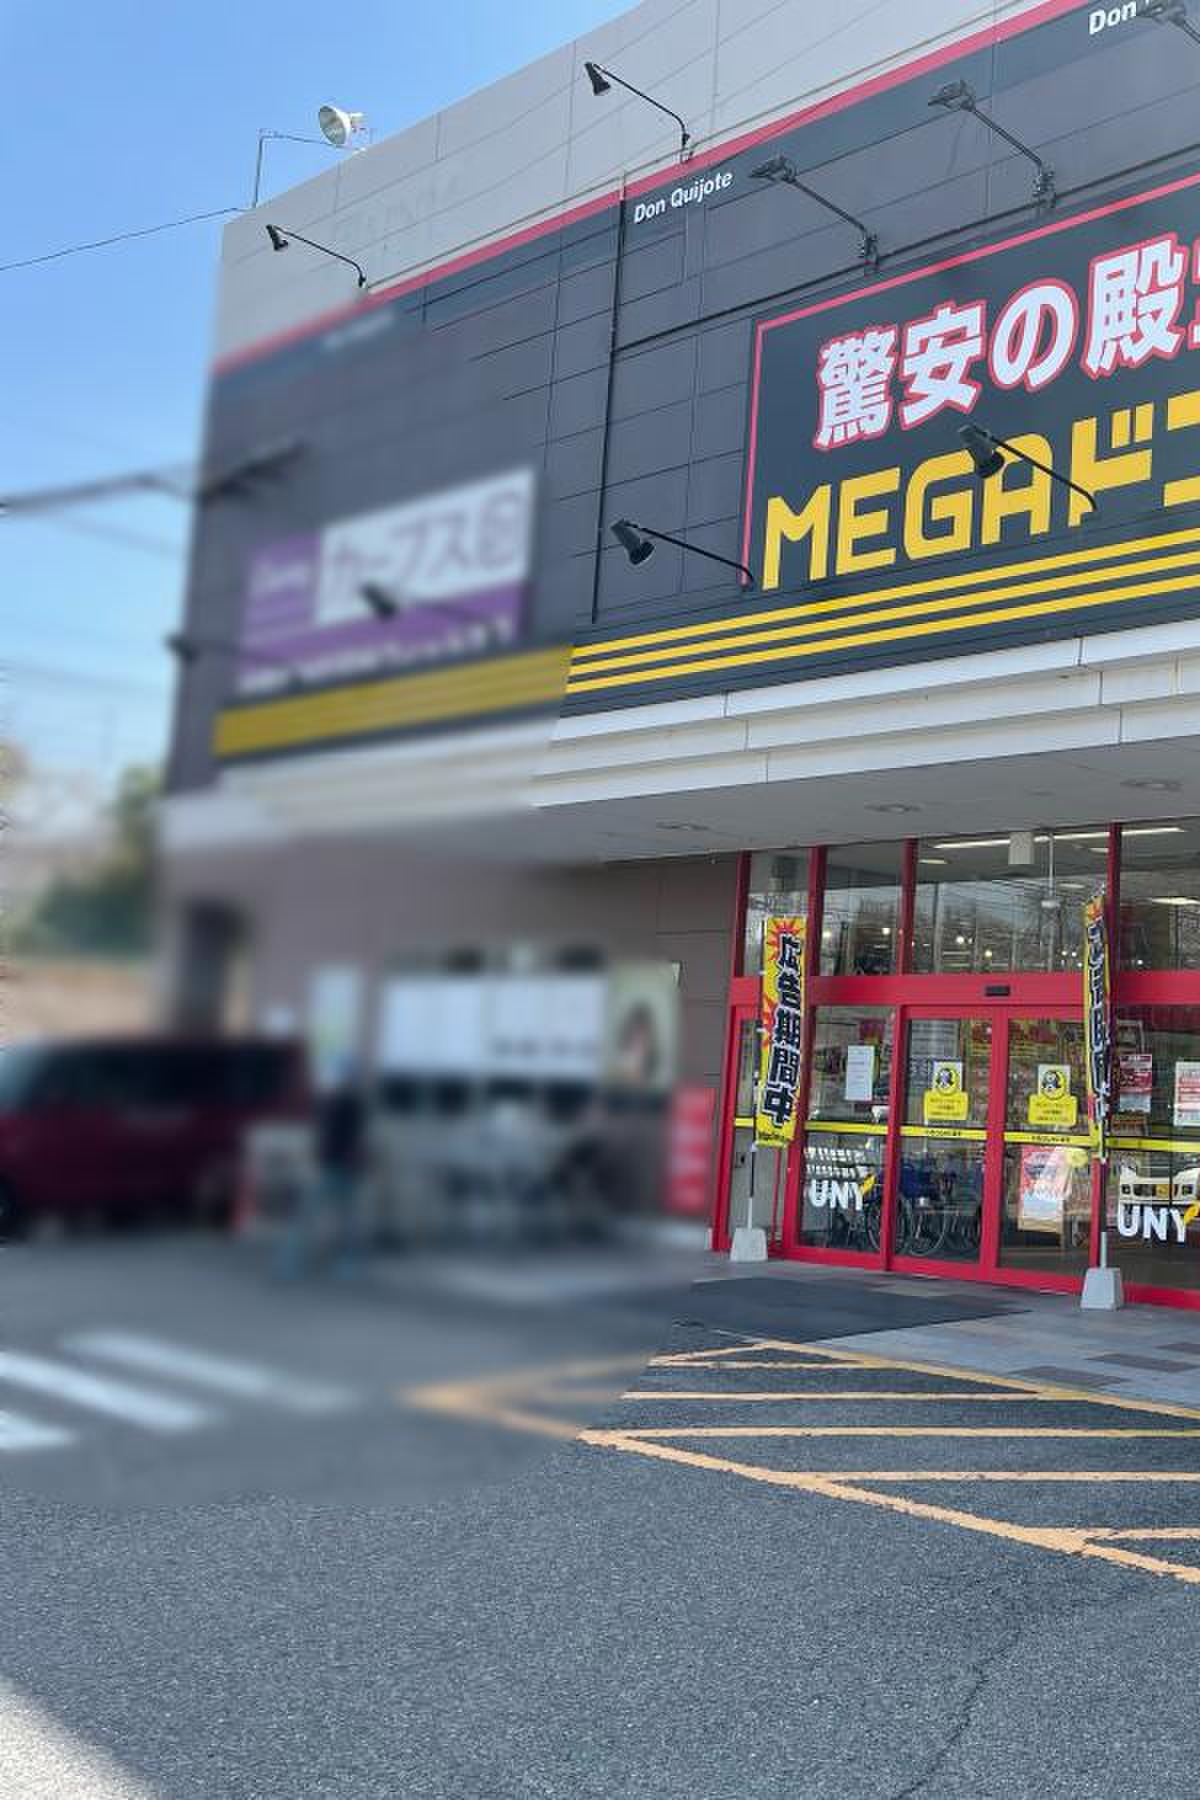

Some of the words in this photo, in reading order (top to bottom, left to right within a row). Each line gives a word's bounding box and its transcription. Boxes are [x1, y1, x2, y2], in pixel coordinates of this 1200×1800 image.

[1089, 1, 1136, 34] Don
[633, 200, 666, 223] Don
[671, 172, 732, 208] Quijote
[811, 1176, 874, 1211] UNY
[1117, 1201, 1199, 1243] UNY
